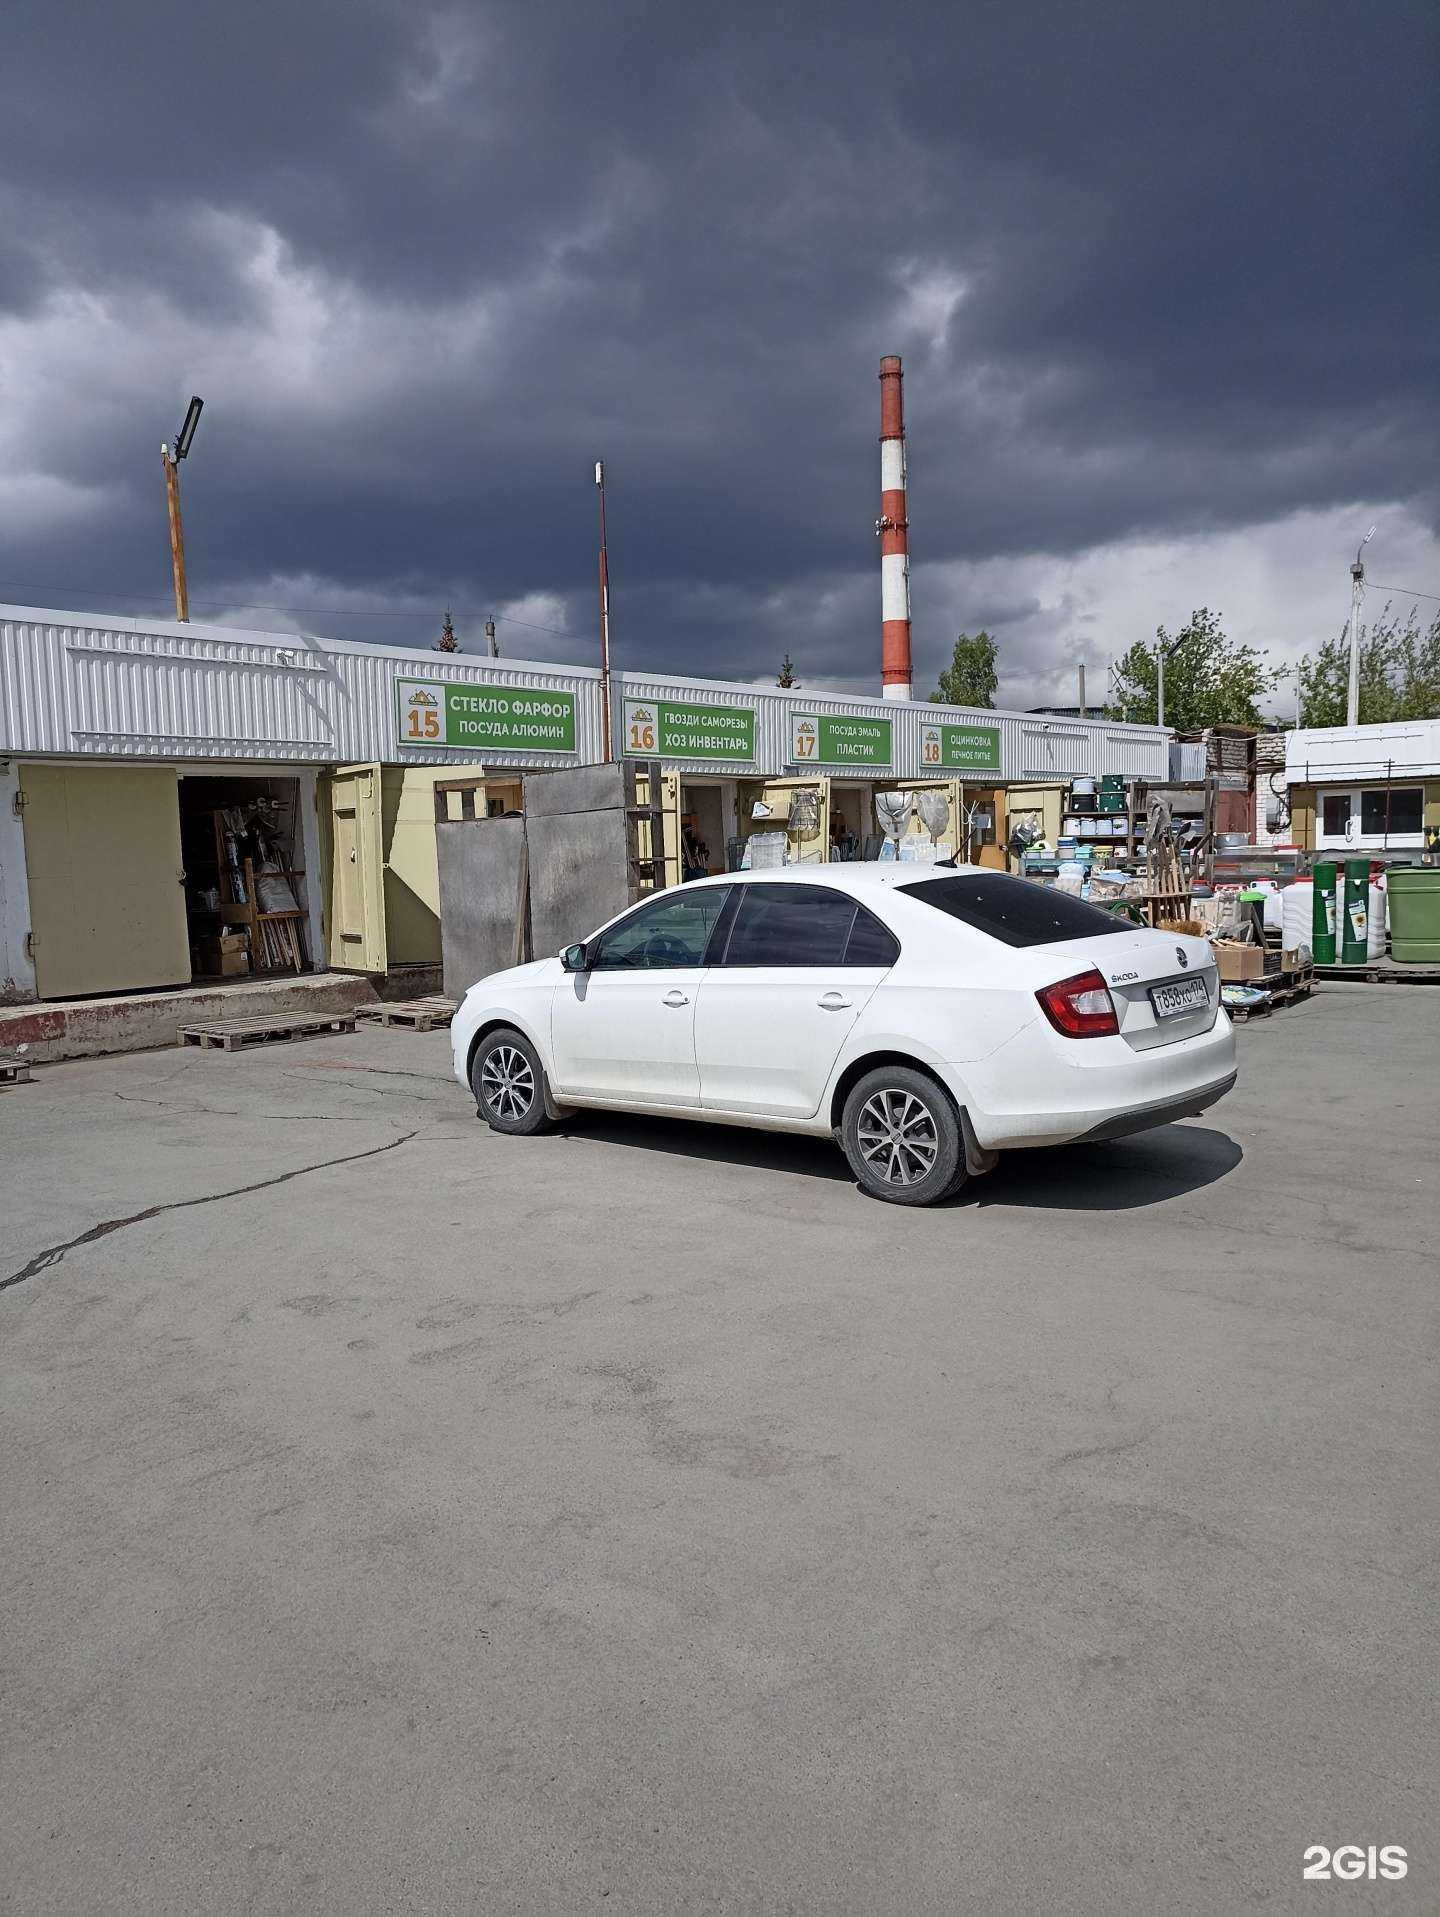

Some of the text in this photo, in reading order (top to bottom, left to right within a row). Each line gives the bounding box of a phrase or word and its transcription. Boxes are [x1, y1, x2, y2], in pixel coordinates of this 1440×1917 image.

[450, 695, 571, 719] СТЕКЛО ФАРФОР
[408, 709, 440, 738] 15
[459, 720, 564, 738] ПОСУДА АЛЮМИН
[664, 712, 748, 729] ГВОЗДИ САМОРЕЗЫ
[630, 725, 655, 749] 16
[829, 725, 881, 737] ПОСУДА ЭМАЛЬ
[664, 733, 748, 750] ХОЗ ИНВЕНТАРЬ
[797, 736, 815, 757] 17
[950, 734, 992, 747] ОЦИНКОВКА
[836, 743, 874, 756] ПЛАСТИК
[925, 743, 939, 761] 18
[951, 750, 974, 760] ПЕЧНОЕ
